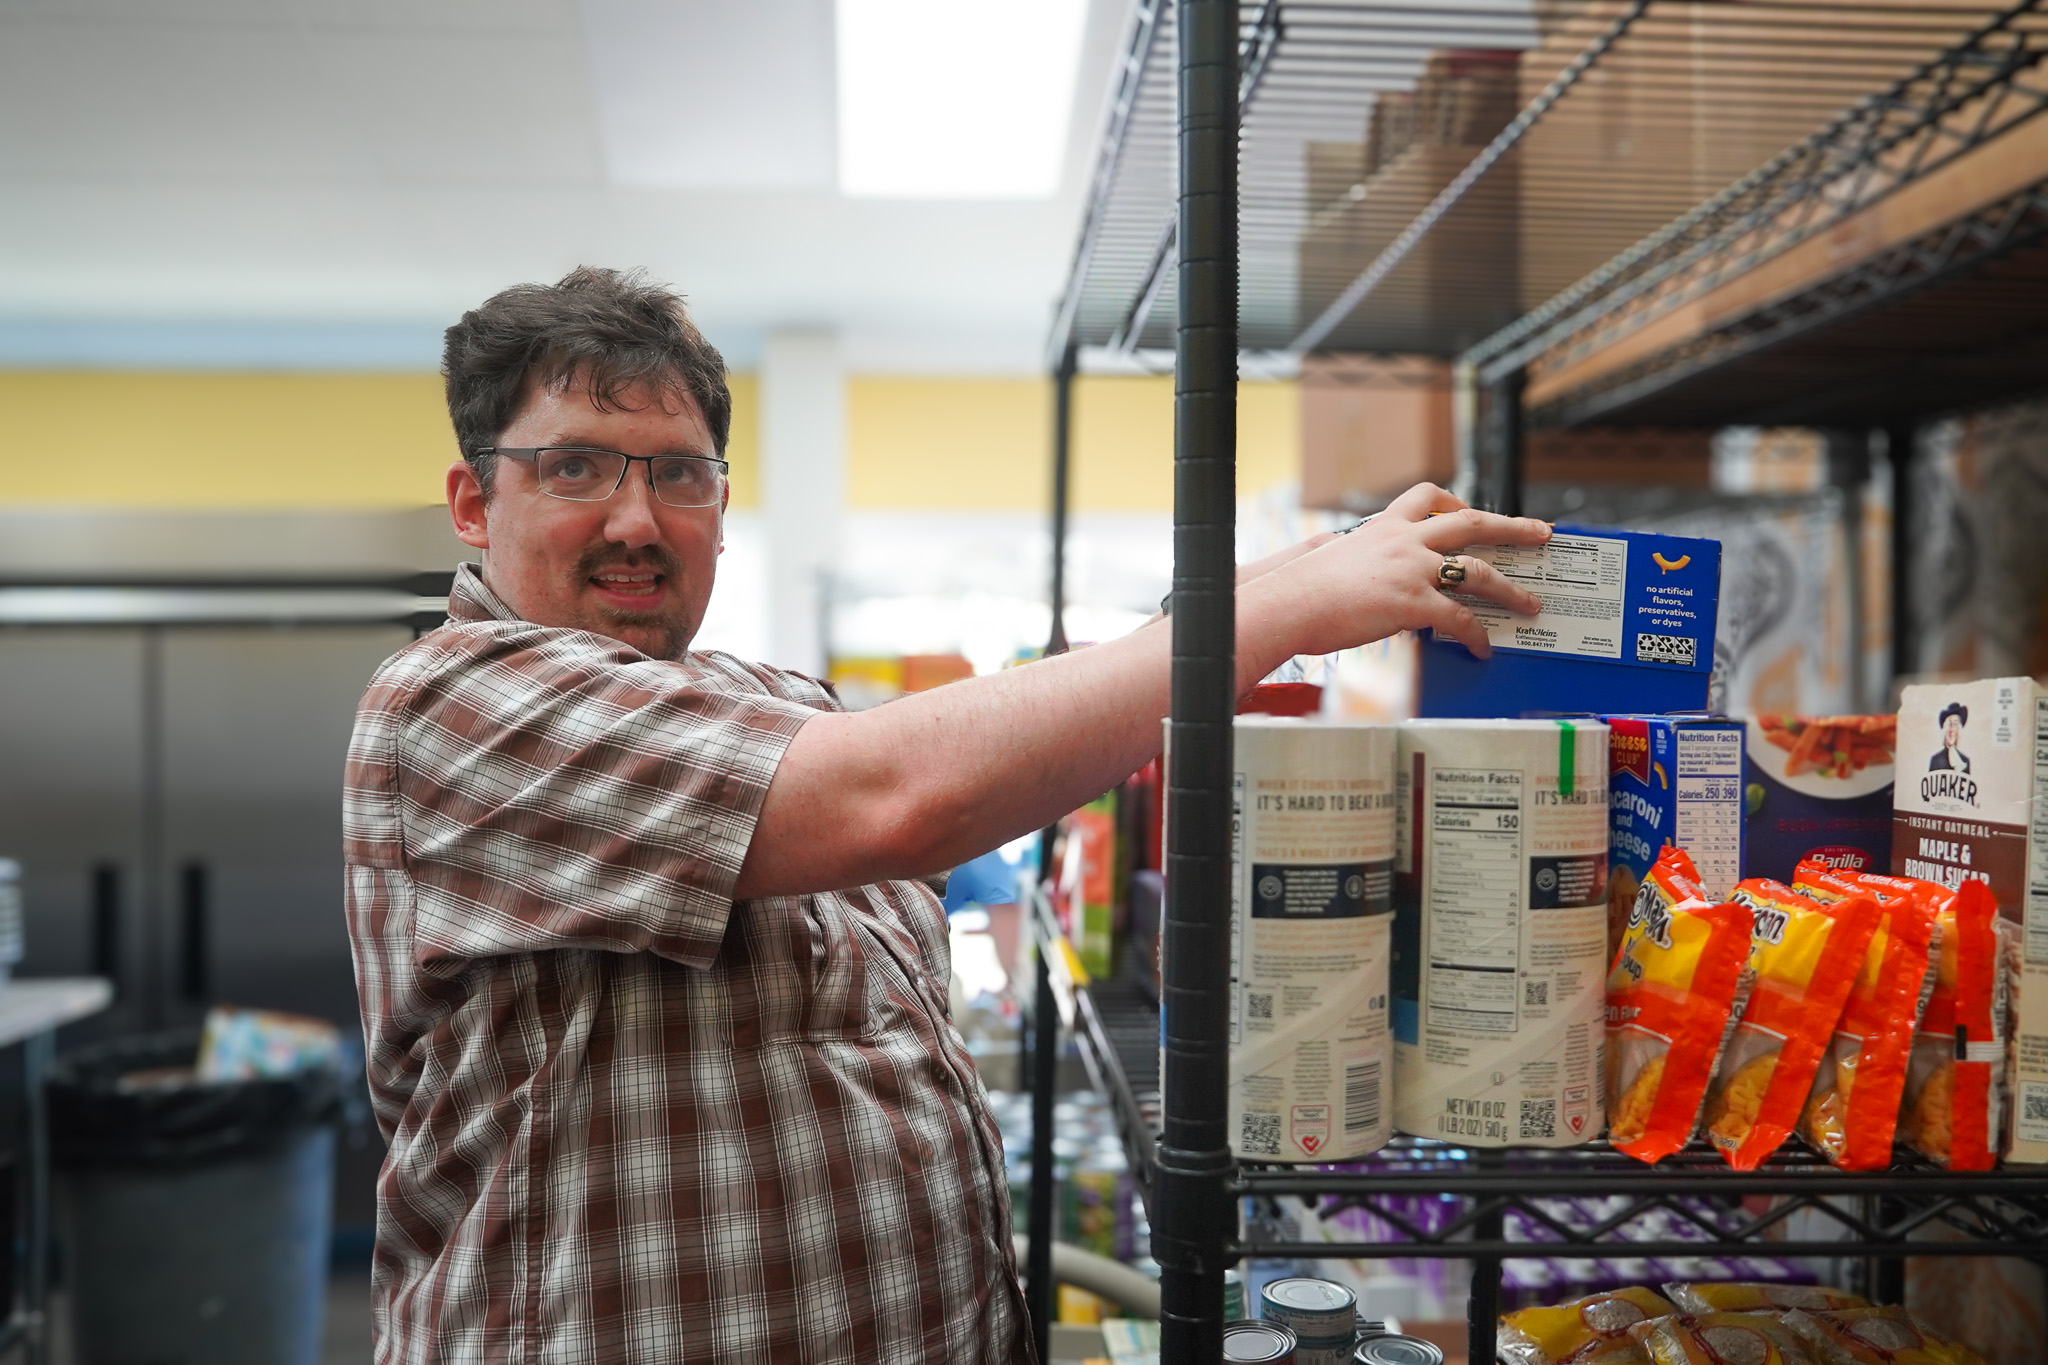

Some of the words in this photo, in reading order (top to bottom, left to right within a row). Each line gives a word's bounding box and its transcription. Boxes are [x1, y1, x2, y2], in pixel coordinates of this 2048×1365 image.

[1658, 586, 1694, 596] artificial
[1652, 596, 1684, 607] flavors,
[1638, 606, 1697, 619] preservatives,
[1662, 618, 1682, 628] dyes
[1516, 640, 1556, 649] 1.800.847.1997
[1679, 733, 1714, 742] Nutrition
[1717, 733, 1739, 742] Facts
[1435, 772, 1485, 783] Nutrition
[1488, 773, 1520, 784] Facts
[1678, 790, 1704, 799] Calories
[1705, 787, 1720, 799] 250
[1722, 787, 1738, 799] 390
[1920, 774, 1978, 806] QUAKER
[1257, 794, 1283, 811] IT'S
[1288, 794, 1326, 811] HARD
[1329, 794, 1345, 810] TO
[1348, 794, 1373, 810] BEAT
[1534, 790, 1558, 806] IT'S
[1561, 790, 1586, 805] HARD
[1608, 790, 1663, 830] acaroni
[1434, 815, 1471, 827] Calories
[1496, 815, 1519, 828] 150
[1616, 814, 1634, 828] and
[1908, 816, 1942, 832] INSTANT
[1944, 821, 1990, 838] OATMEAL
[1608, 828, 1651, 862] heese
[1918, 837, 1959, 863] MAPLE
[1960, 844, 1971, 865] &
[1811, 853, 1864, 868] Barilla
[1905, 858, 1944, 883] BROWN
[1858, 874, 1893, 886] Chicken
[1446, 1098, 1464, 1115] NET
[1466, 1100, 1481, 1116] WT
[1482, 1100, 1492, 1117] 18
[1492, 1101, 1506, 1118] OZ
[1446, 1118, 1458, 1134] LB
[1458, 1118, 1465, 1134] 2
[1466, 1119, 1482, 1137] OZ)
[1485, 1121, 1500, 1138] 510
[1502, 1124, 1508, 1142] g
